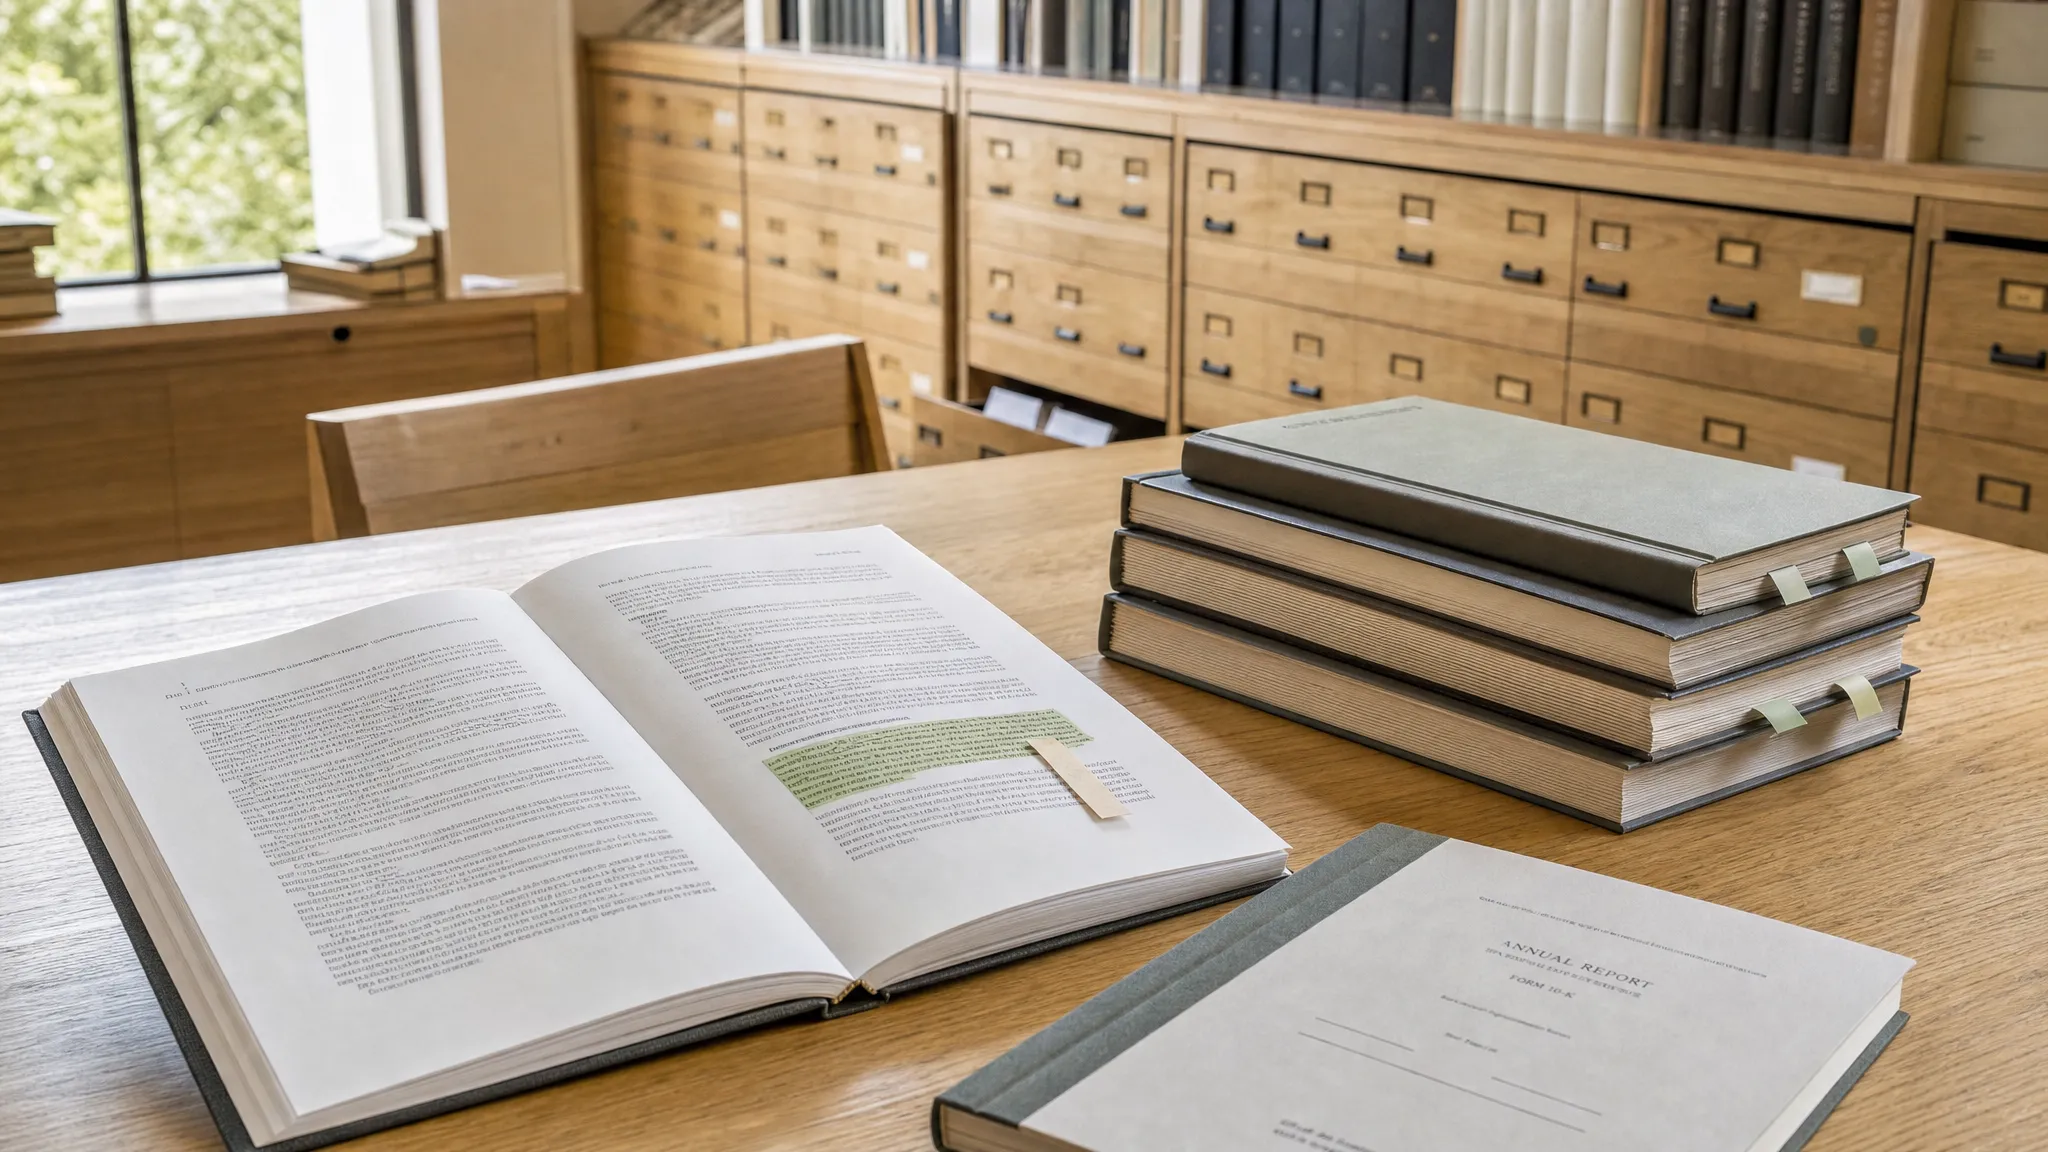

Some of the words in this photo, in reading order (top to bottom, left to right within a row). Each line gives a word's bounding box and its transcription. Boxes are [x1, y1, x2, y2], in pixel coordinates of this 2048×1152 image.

[1502, 940, 1574, 967] ANNUAL
[1581, 963, 1654, 990] REPORT
[1509, 974, 1545, 990] FORM
